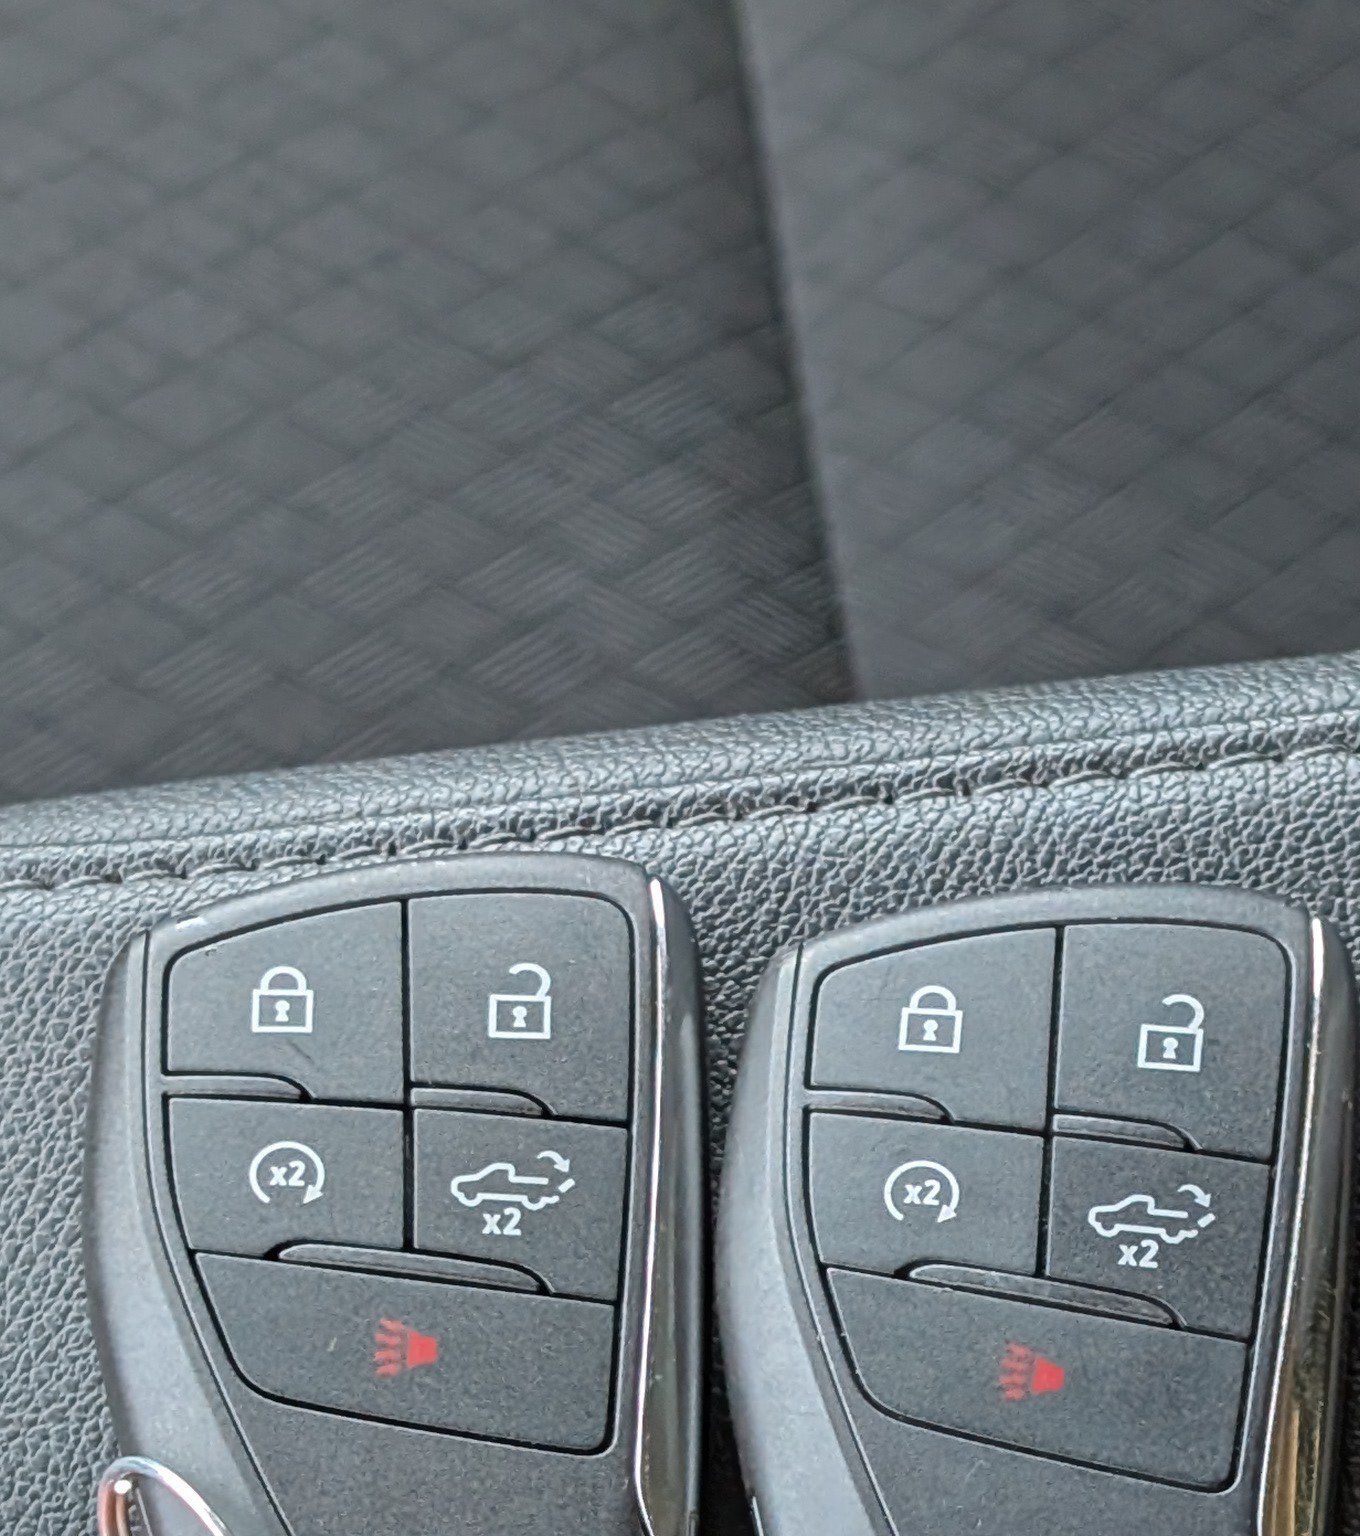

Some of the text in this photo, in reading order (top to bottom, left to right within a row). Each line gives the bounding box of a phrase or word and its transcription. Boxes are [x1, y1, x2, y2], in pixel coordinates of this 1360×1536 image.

[269, 1160, 307, 1188] x2
[903, 1179, 942, 1207] x2
[481, 1207, 522, 1236] x2
[1116, 1238, 1159, 1269] x2
